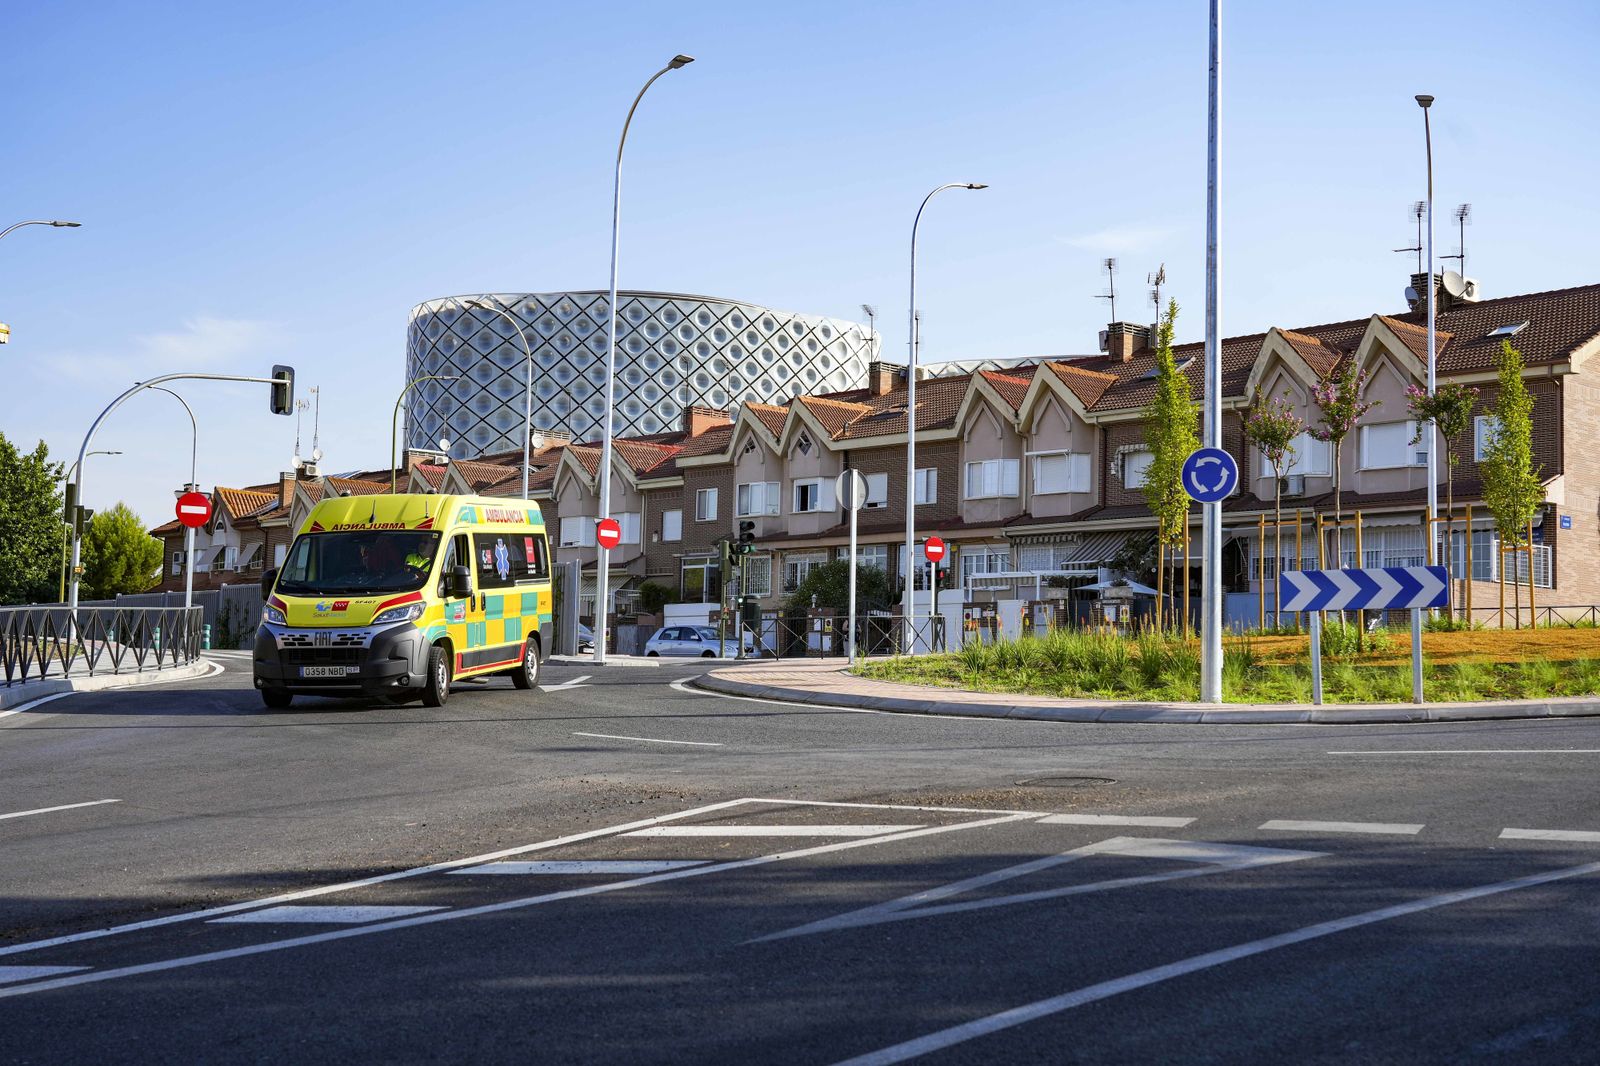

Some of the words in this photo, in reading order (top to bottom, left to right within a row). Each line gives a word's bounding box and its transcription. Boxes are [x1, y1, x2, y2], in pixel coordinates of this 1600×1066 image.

[485, 508, 525, 524] AMBULANCIA
[314, 632, 333, 647] FIAT
[305, 667, 326, 676] 0358
